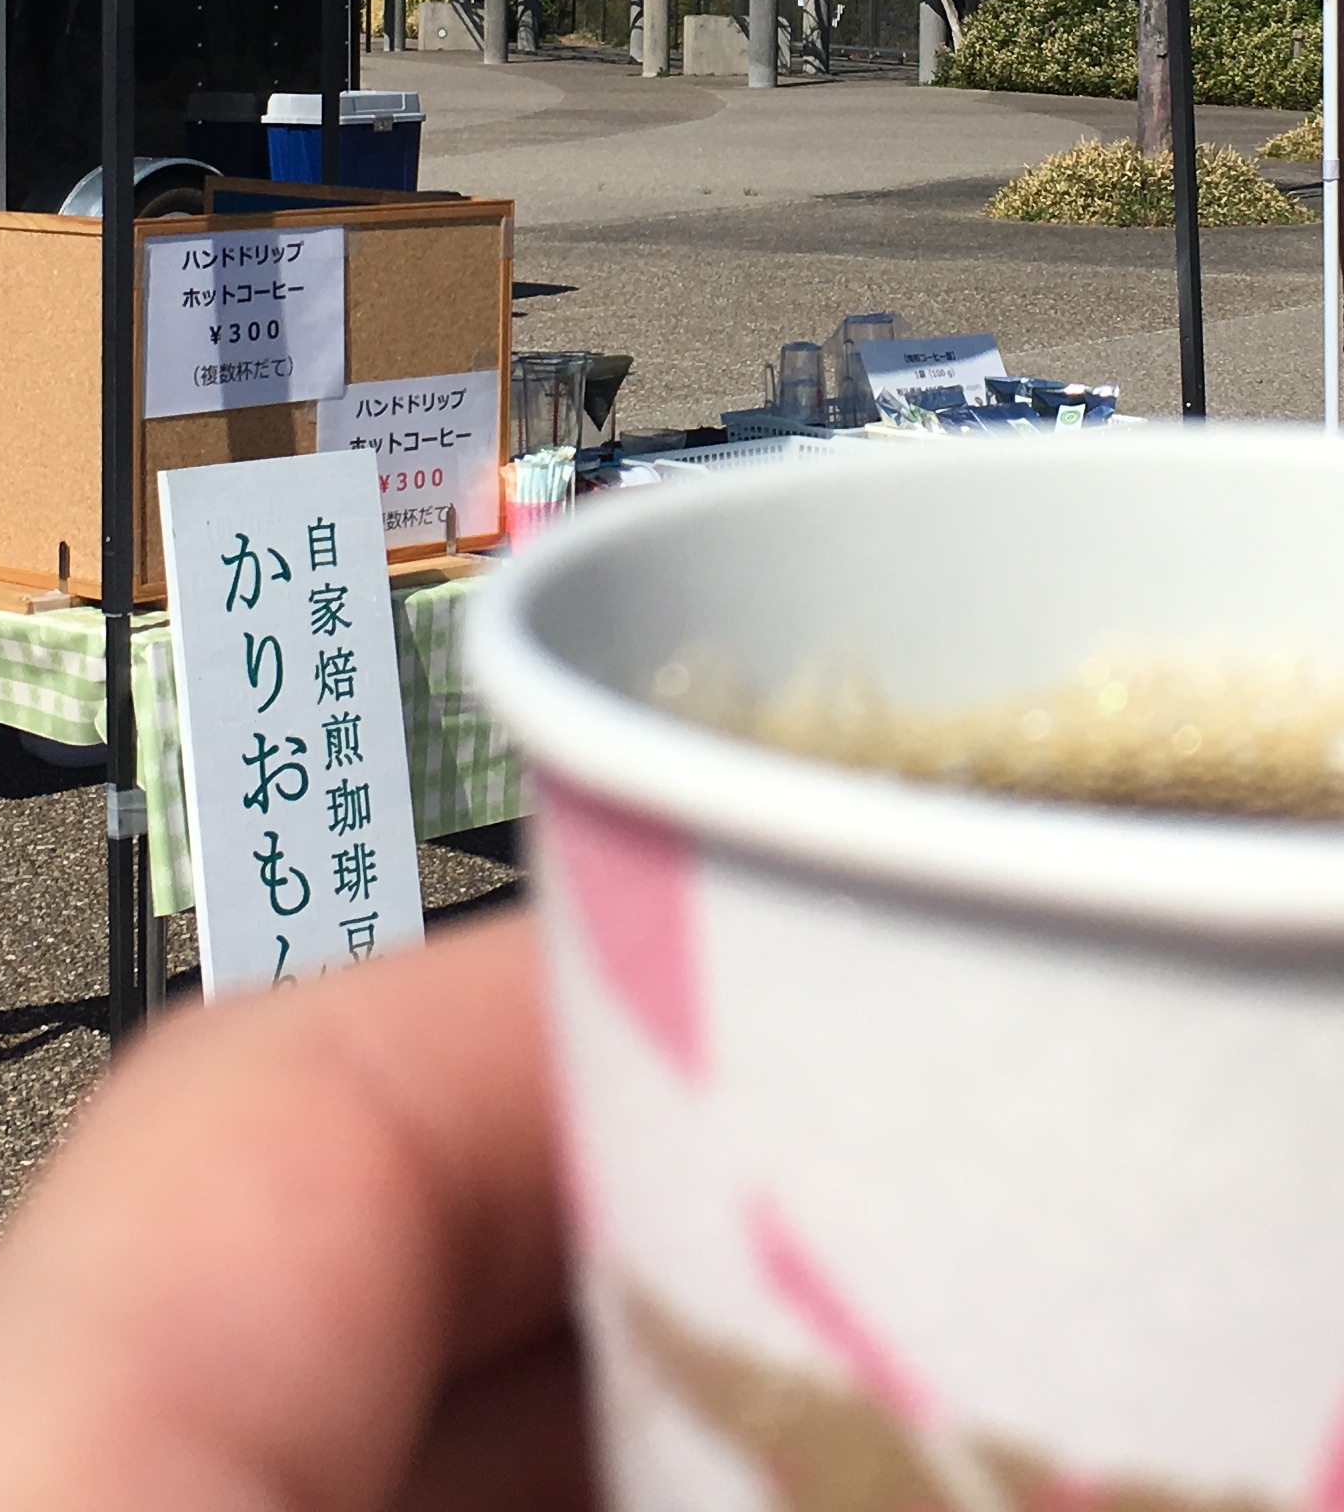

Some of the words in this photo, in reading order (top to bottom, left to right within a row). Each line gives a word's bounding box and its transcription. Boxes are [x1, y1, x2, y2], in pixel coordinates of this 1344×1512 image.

[182, 240, 305, 270] ハンドドリップ
[182, 280, 305, 308] ホットコーヒー
[355, 388, 468, 419] ハンドドリップ
[349, 427, 472, 454] ホットコーヒー
